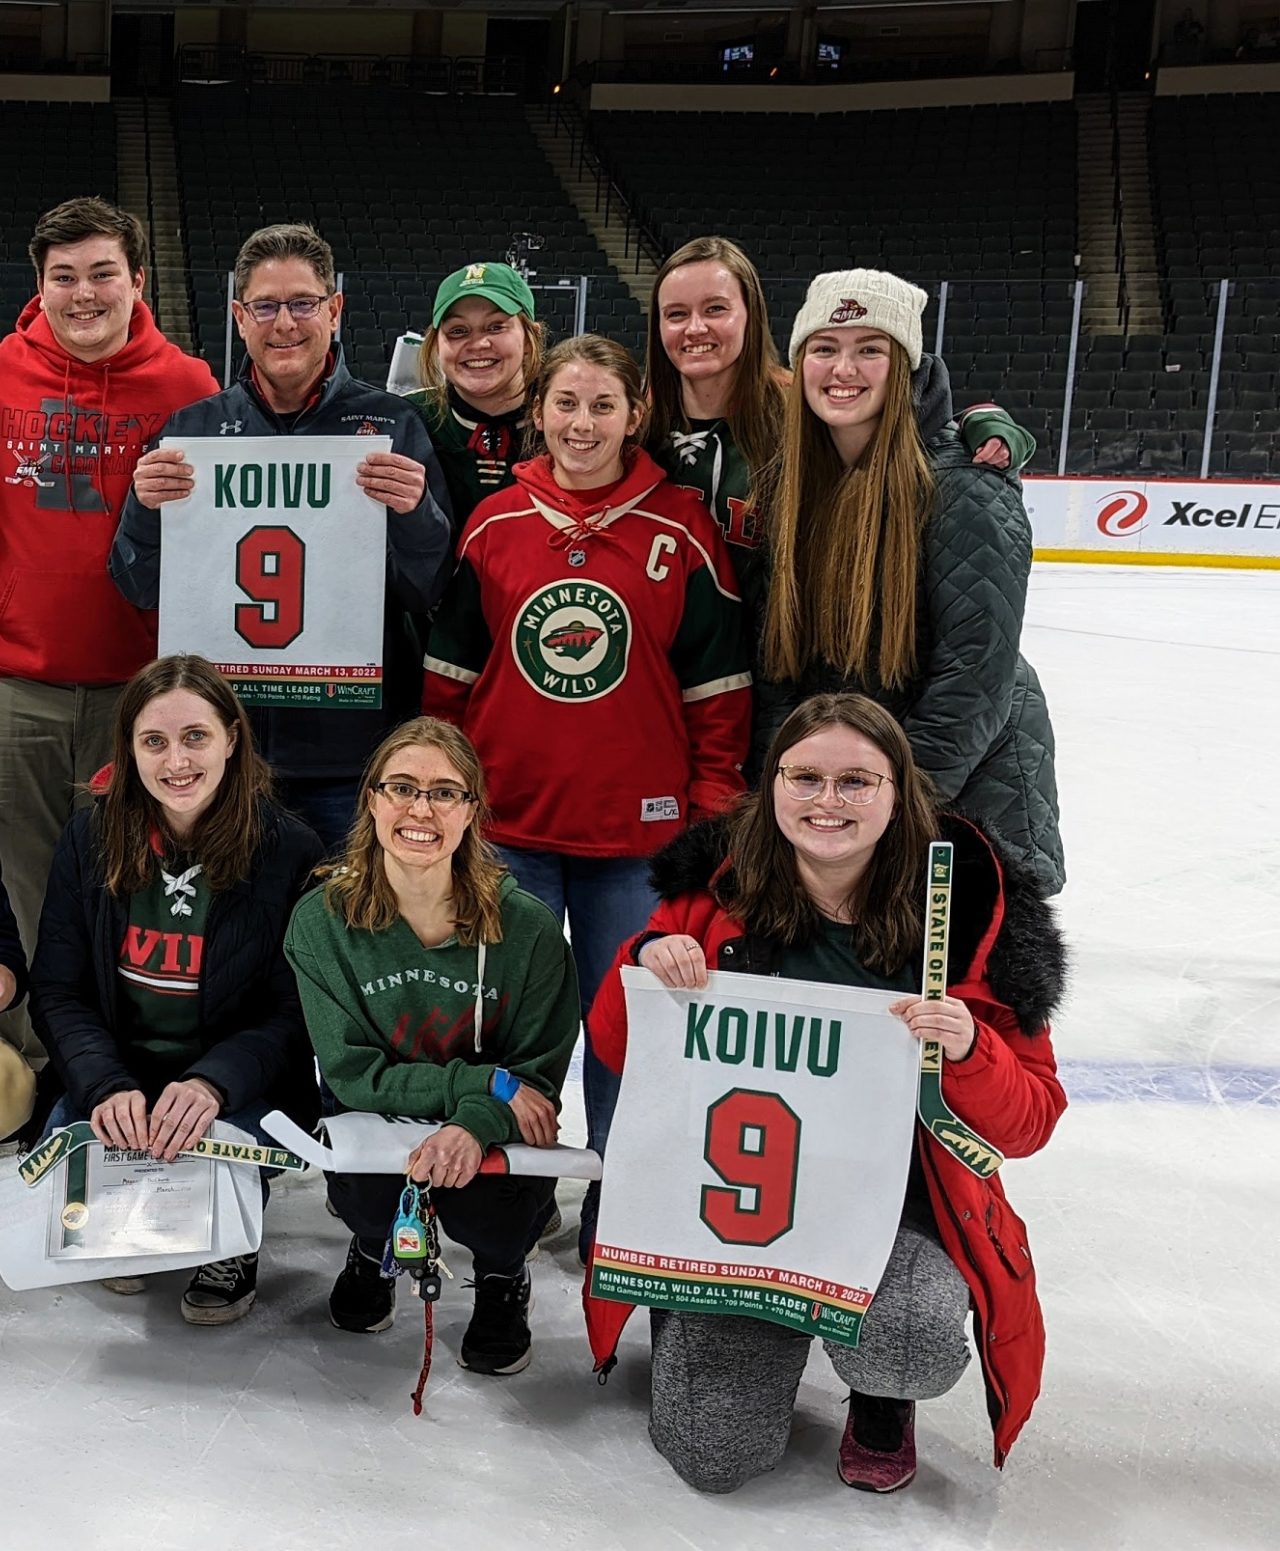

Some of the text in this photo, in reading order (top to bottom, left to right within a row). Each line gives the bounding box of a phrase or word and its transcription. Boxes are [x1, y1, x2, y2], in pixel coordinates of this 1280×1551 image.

[1, 408, 159, 443] HOCKEY
[6, 440, 60, 452] SAINT
[214, 463, 331, 508] KOIVU
[1162, 501, 1280, 529] Xcel E
[646, 533, 677, 582] C
[235, 525, 306, 649] 9
[524, 588, 624, 635] MINNESOTA
[252, 666, 292, 675] SUNDAY
[295, 667, 331, 676] MARCH
[335, 669, 349, 677] 13,
[352, 669, 376, 677] 2022
[543, 671, 598, 693] WILD
[242, 684, 259, 692] ALL
[262, 685, 283, 693] TIME
[286, 685, 320, 694] LEADER
[929, 893, 947, 952] STATE
[360, 968, 498, 1000] MINNESOTA
[928, 959, 944, 982] OF
[684, 1002, 842, 1078] KOIVU
[104, 1152, 126, 1162] FIRST
[127, 1151, 148, 1161] GAME
[211, 1143, 263, 1161] STATE
[699, 1087, 802, 1247] 9
[601, 1246, 866, 1304] NUMBER RETIRED SUNDAY MARCH 13, 2022
[599, 1271, 808, 1313] MINNESOTA WILD ALL TIME LEADER
[616, 1286, 642, 1297] Games
[643, 1290, 669, 1301] Played
[689, 1297, 718, 1305] Assists
[739, 1301, 763, 1310] Points
